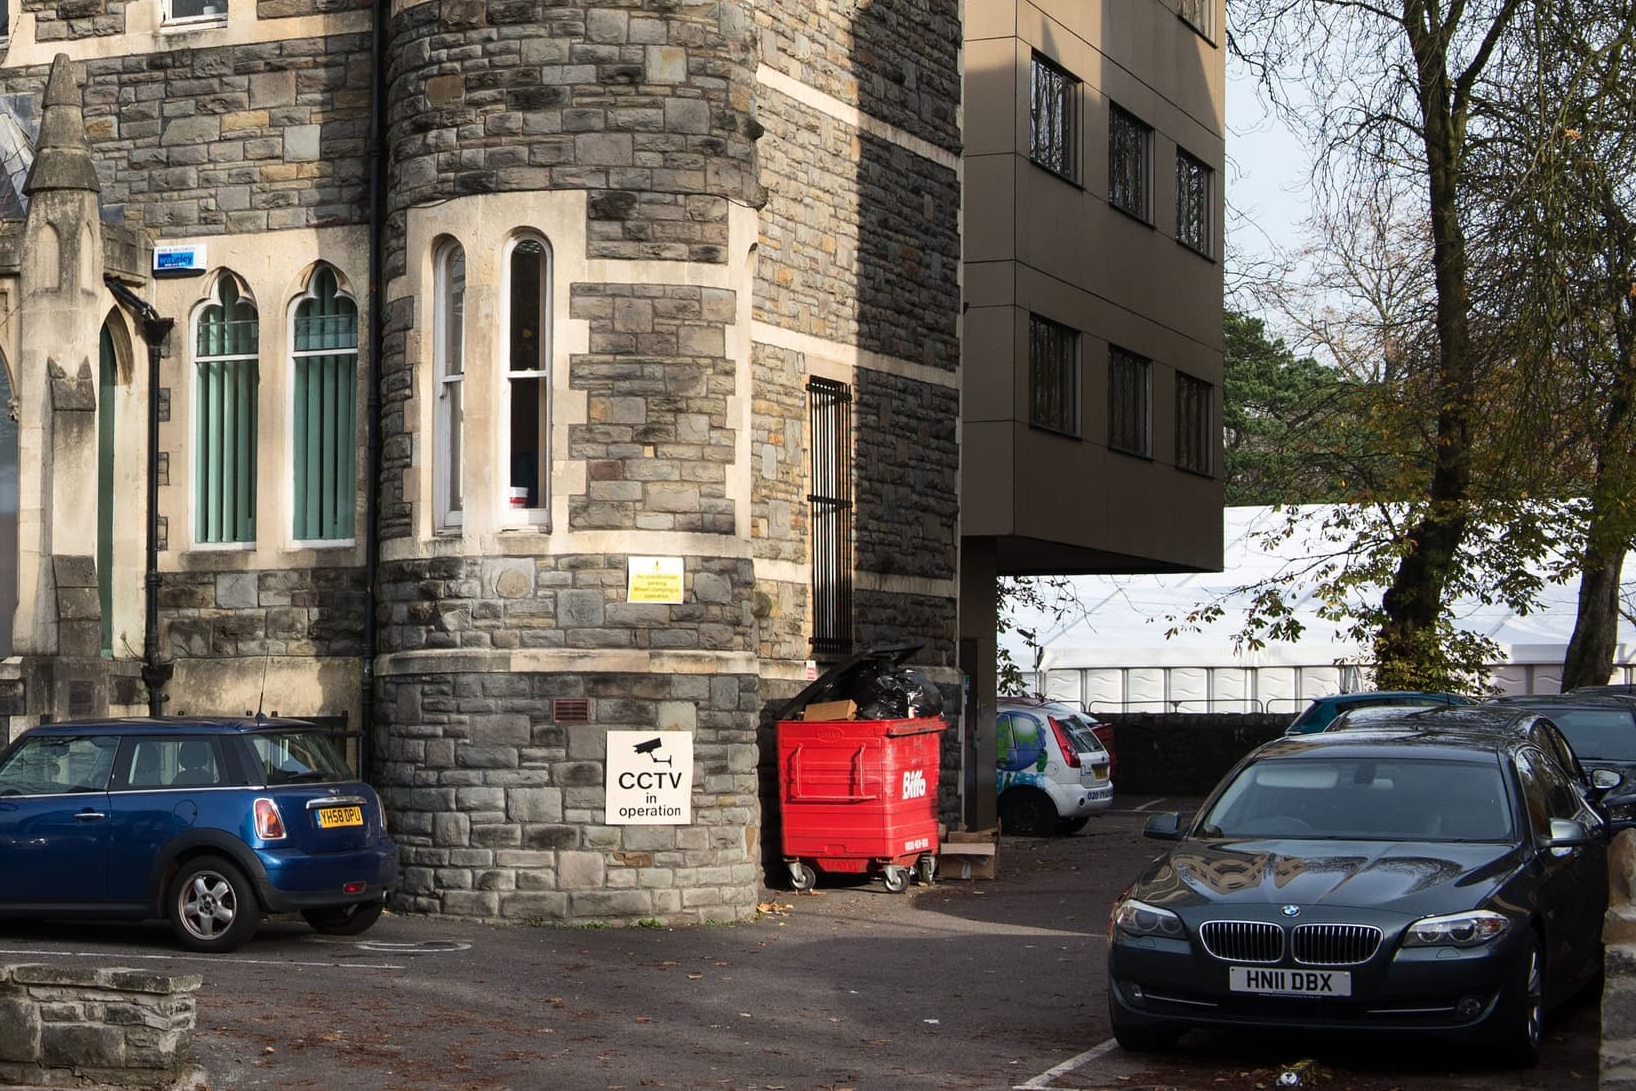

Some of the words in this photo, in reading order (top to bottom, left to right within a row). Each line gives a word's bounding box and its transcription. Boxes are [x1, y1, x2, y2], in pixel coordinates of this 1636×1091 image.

[618, 772, 682, 790] CCTV
[646, 792, 657, 804] in
[320, 809, 344, 824] YH58
[345, 808, 361, 822] DPU
[619, 804, 681, 819] operation
[1247, 970, 1284, 990] HN11
[1291, 972, 1333, 992] DBX
